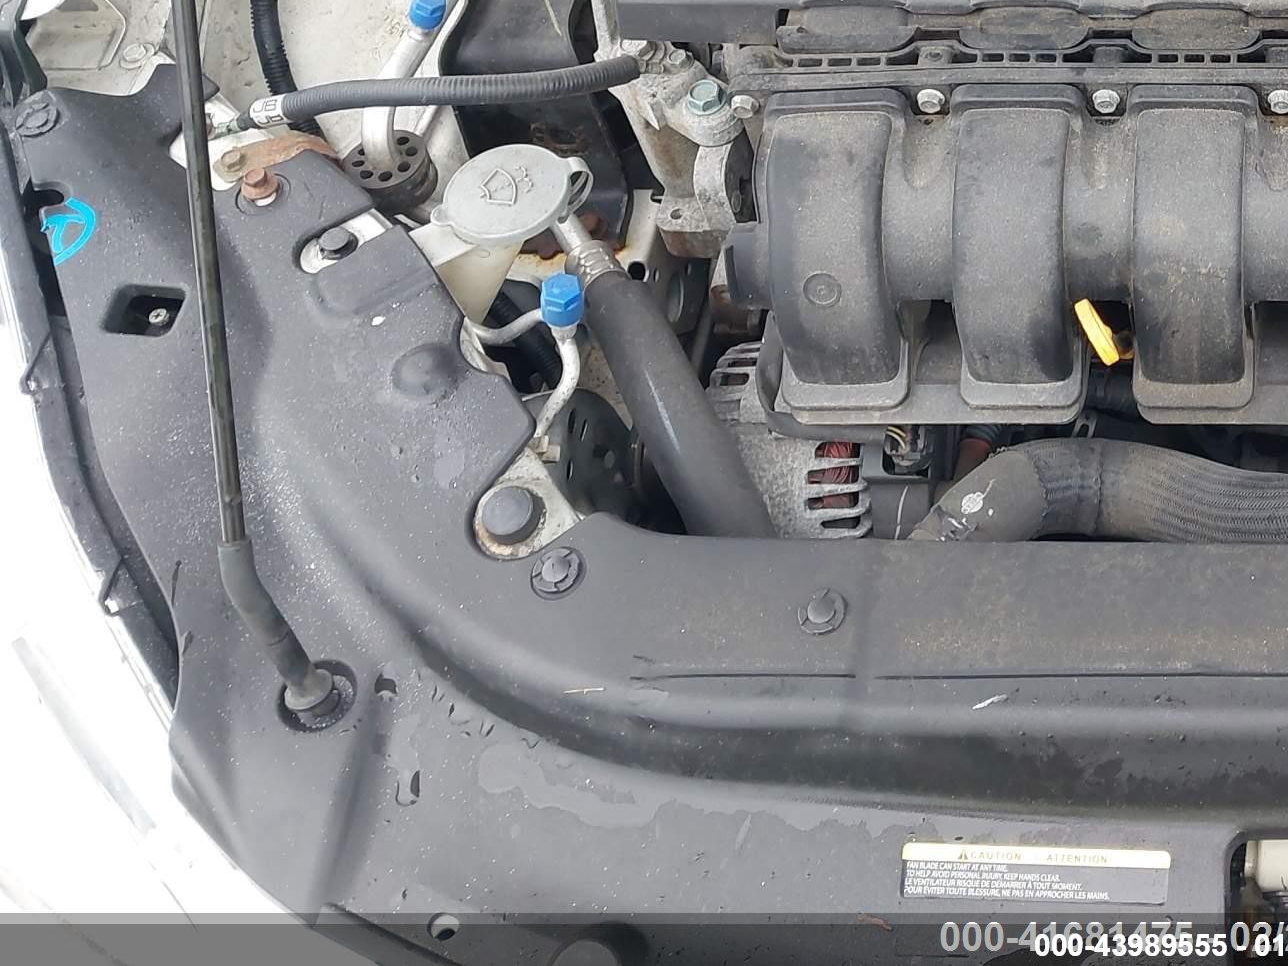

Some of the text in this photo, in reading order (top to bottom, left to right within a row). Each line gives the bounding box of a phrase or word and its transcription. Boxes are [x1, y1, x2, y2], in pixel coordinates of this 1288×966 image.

[970, 852, 1022, 861] CAUTION
[1046, 854, 1108, 863] ATTENTION
[906, 861, 918, 869] FAN
[919, 862, 939, 870] BLADE
[952, 863, 971, 871] START
[916, 870, 931, 878] HELP
[950, 871, 981, 879] PERSONAL
[1019, 874, 1040, 882] HANDS
[913, 878, 956, 886] VENTILATEUR
[956, 879, 980, 887] RISQUE
[980, 880, 991, 888] DE
[1033, 882, 1051, 890] TOUT
[904, 886, 922, 894] POUR
[1024, 890, 1034, 898] EN
[1035, 891, 1074, 899] APPROCHER
